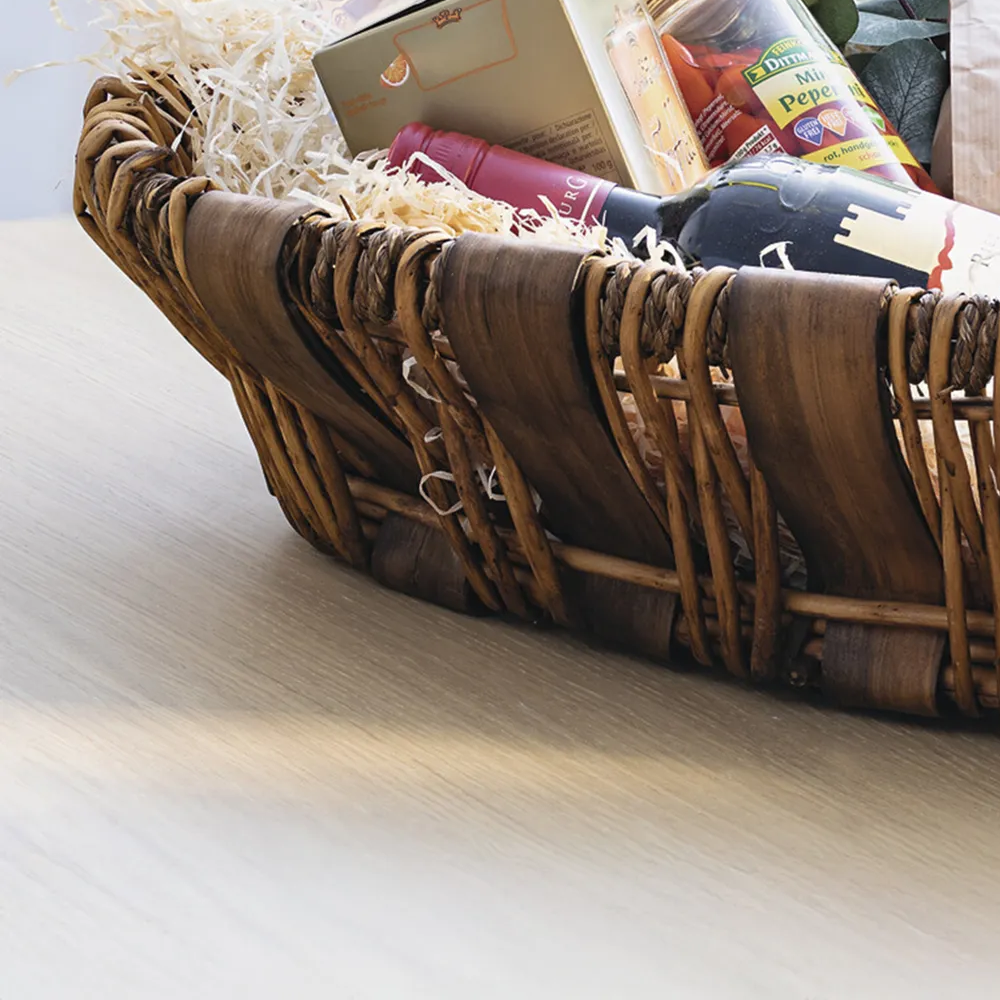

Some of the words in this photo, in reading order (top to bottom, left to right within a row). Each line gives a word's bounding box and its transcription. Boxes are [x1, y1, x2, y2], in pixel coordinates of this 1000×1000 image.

[797, 120, 819, 134] GLUTEN
[803, 127, 820, 139] FREI
[745, 130, 764, 148] Produkt
[559, 175, 588, 216] URG
